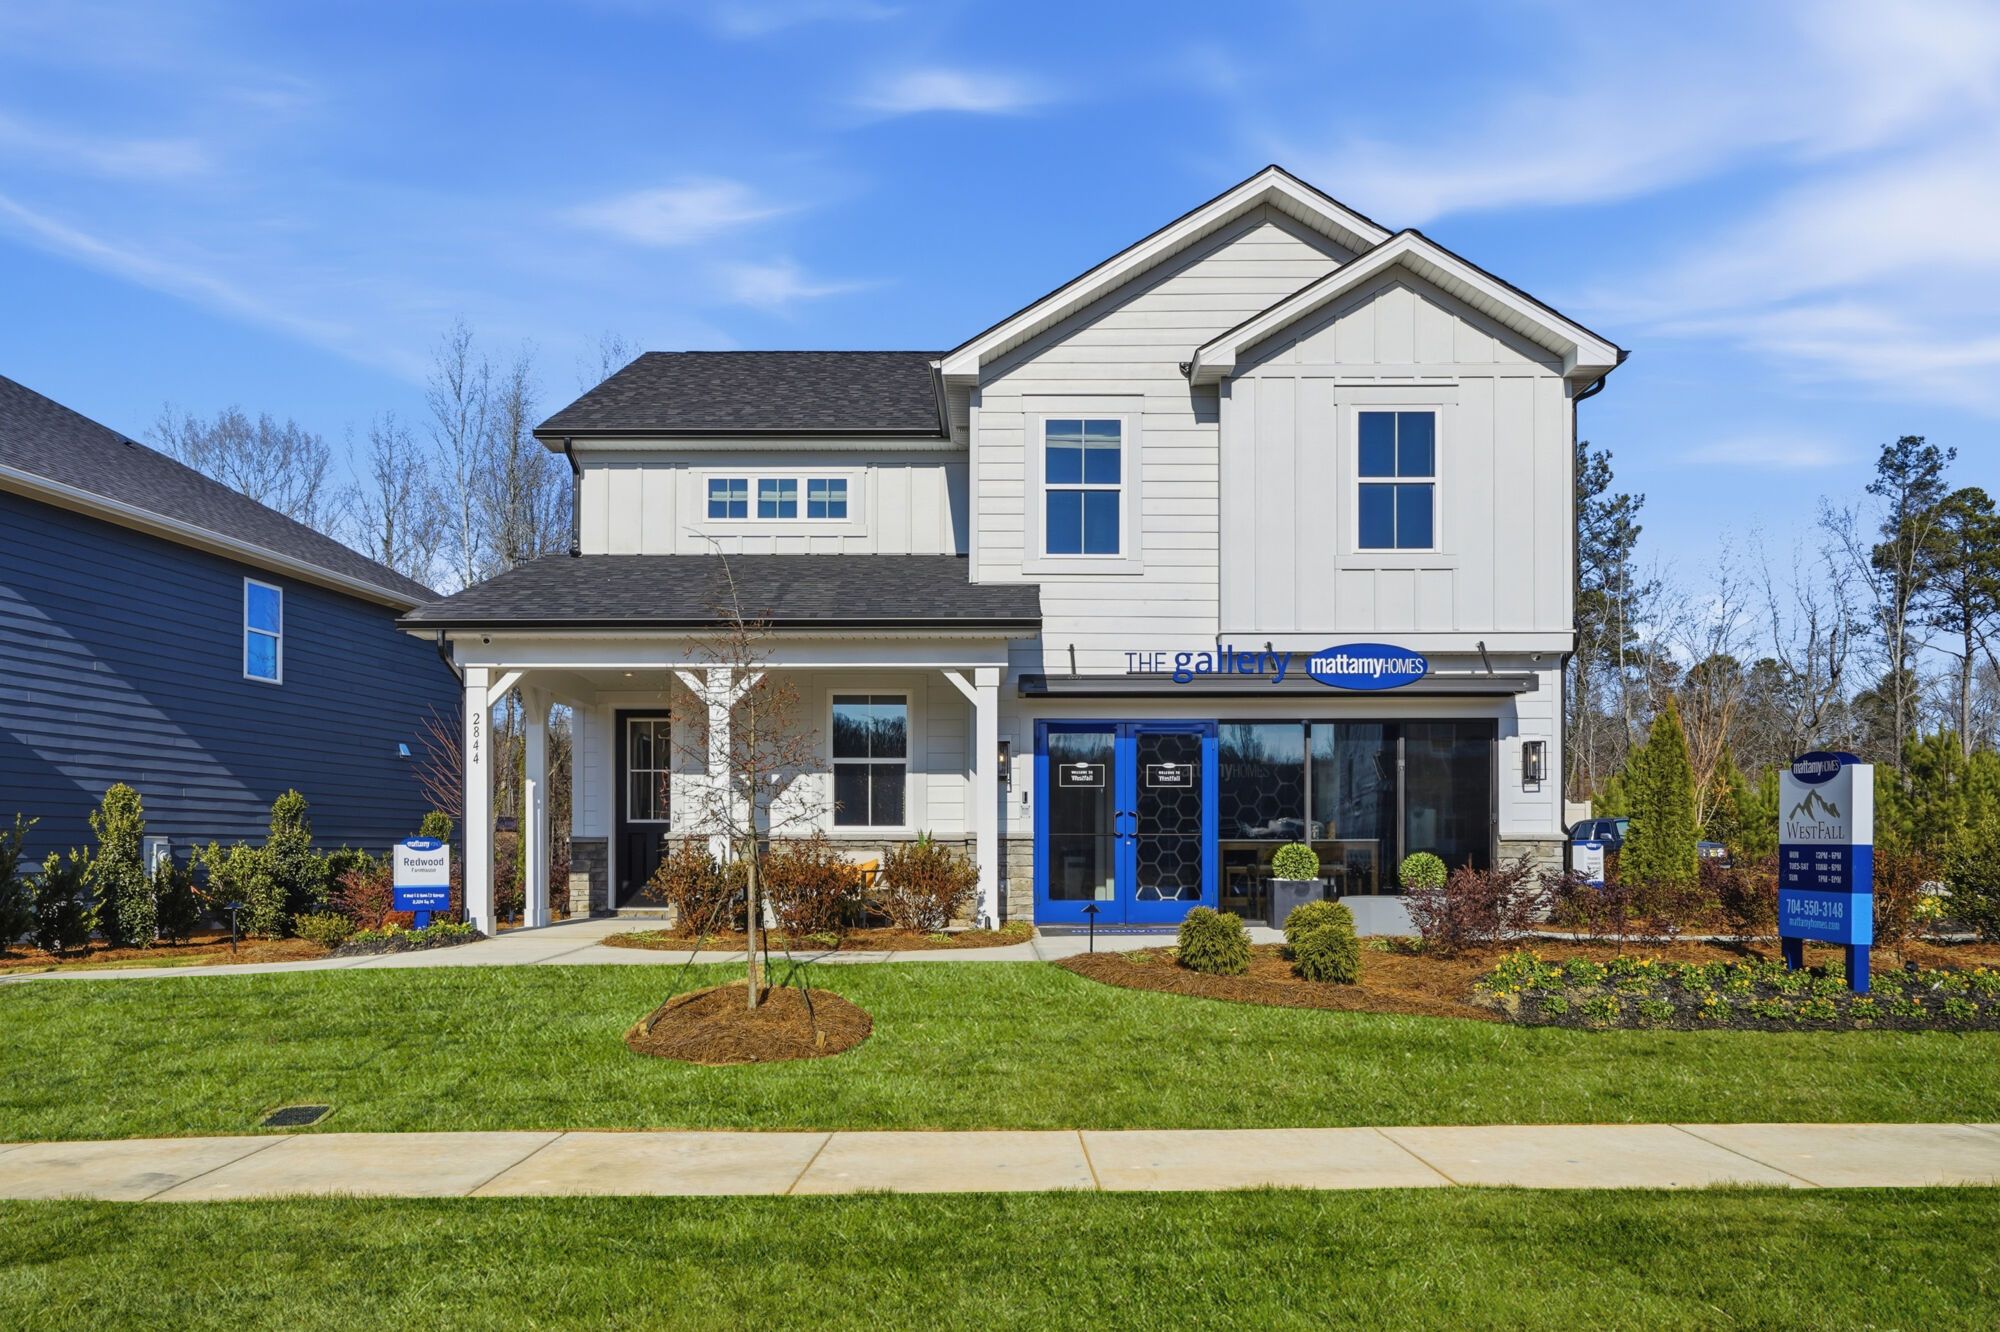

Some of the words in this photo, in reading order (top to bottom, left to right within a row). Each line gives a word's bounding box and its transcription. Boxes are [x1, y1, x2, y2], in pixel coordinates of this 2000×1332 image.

[1125, 652, 1167, 674] THE
[1172, 644, 1293, 684] gallery
[1310, 654, 1424, 678] mattamyHOMES
[472, 712, 481, 765] 2844
[1793, 759, 1840, 776] mattamyHOMES
[403, 857, 444, 866] Redwood
[1786, 898, 1844, 918] 704-550-3148
